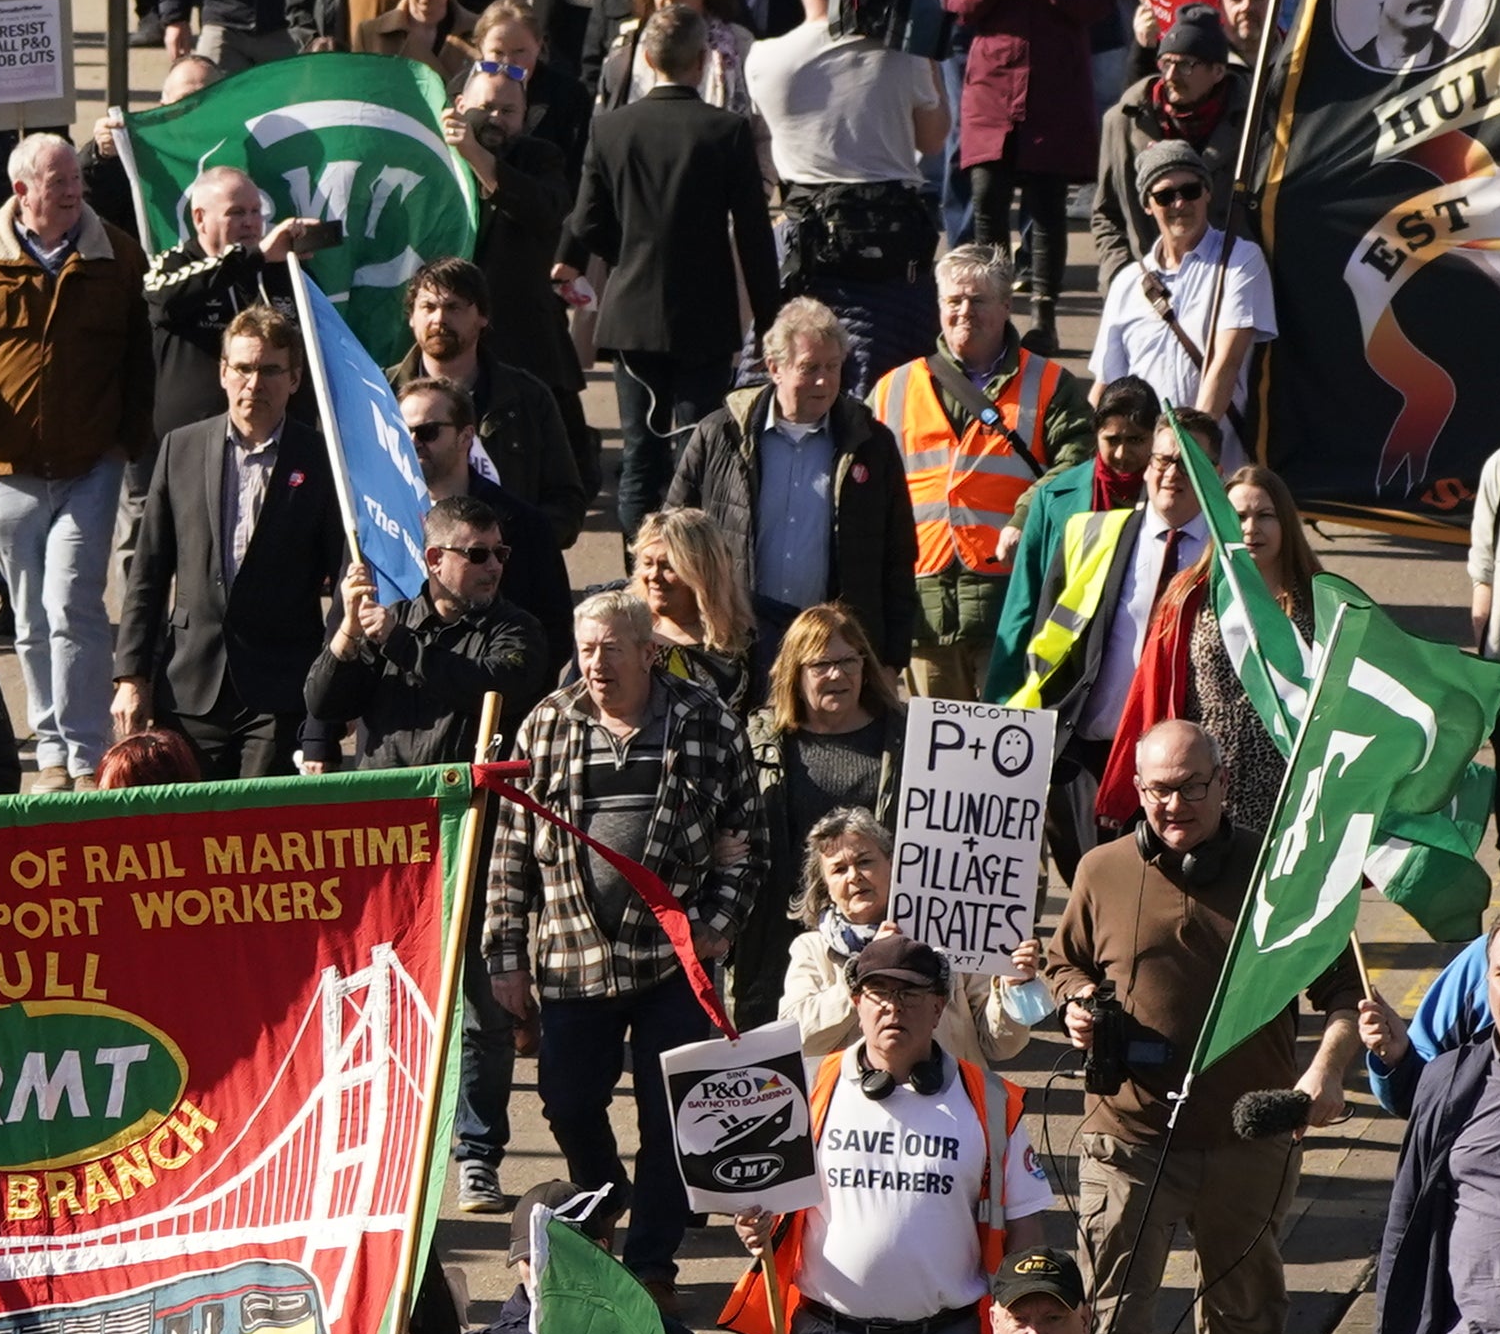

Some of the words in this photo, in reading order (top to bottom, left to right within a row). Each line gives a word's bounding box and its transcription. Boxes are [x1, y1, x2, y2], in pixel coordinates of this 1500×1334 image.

[20, 50, 55, 65] CUTS
[22, 36, 51, 51] P&O
[1362, 194, 1472, 283] EST
[363, 495, 400, 540] The
[932, 700, 1036, 723] BOYCOTT
[904, 787, 1040, 842] PLUNDER
[10, 847, 68, 890] OF
[83, 840, 186, 883] RAIL
[202, 822, 431, 874] MARITIME
[897, 842, 1023, 898] PILLAGE
[131, 877, 343, 930] WORKERS
[894, 893, 1027, 957] PIRATES
[701, 1079, 752, 1100] P&O
[726, 1070, 749, 1079] SINK
[688, 1100, 708, 1109] SAY
[710, 1100, 724, 1108] NO
[726, 1099, 740, 1107] TO
[742, 1087, 792, 1107] SCABBING
[828, 1128, 895, 1154] SAVE
[904, 1133, 960, 1161] OUR
[7, 1099, 219, 1221] BRANCH
[731, 1161, 771, 1178] RMT
[827, 1167, 954, 1195] SEAFARERS
[1023, 1260, 1054, 1272] RMT
